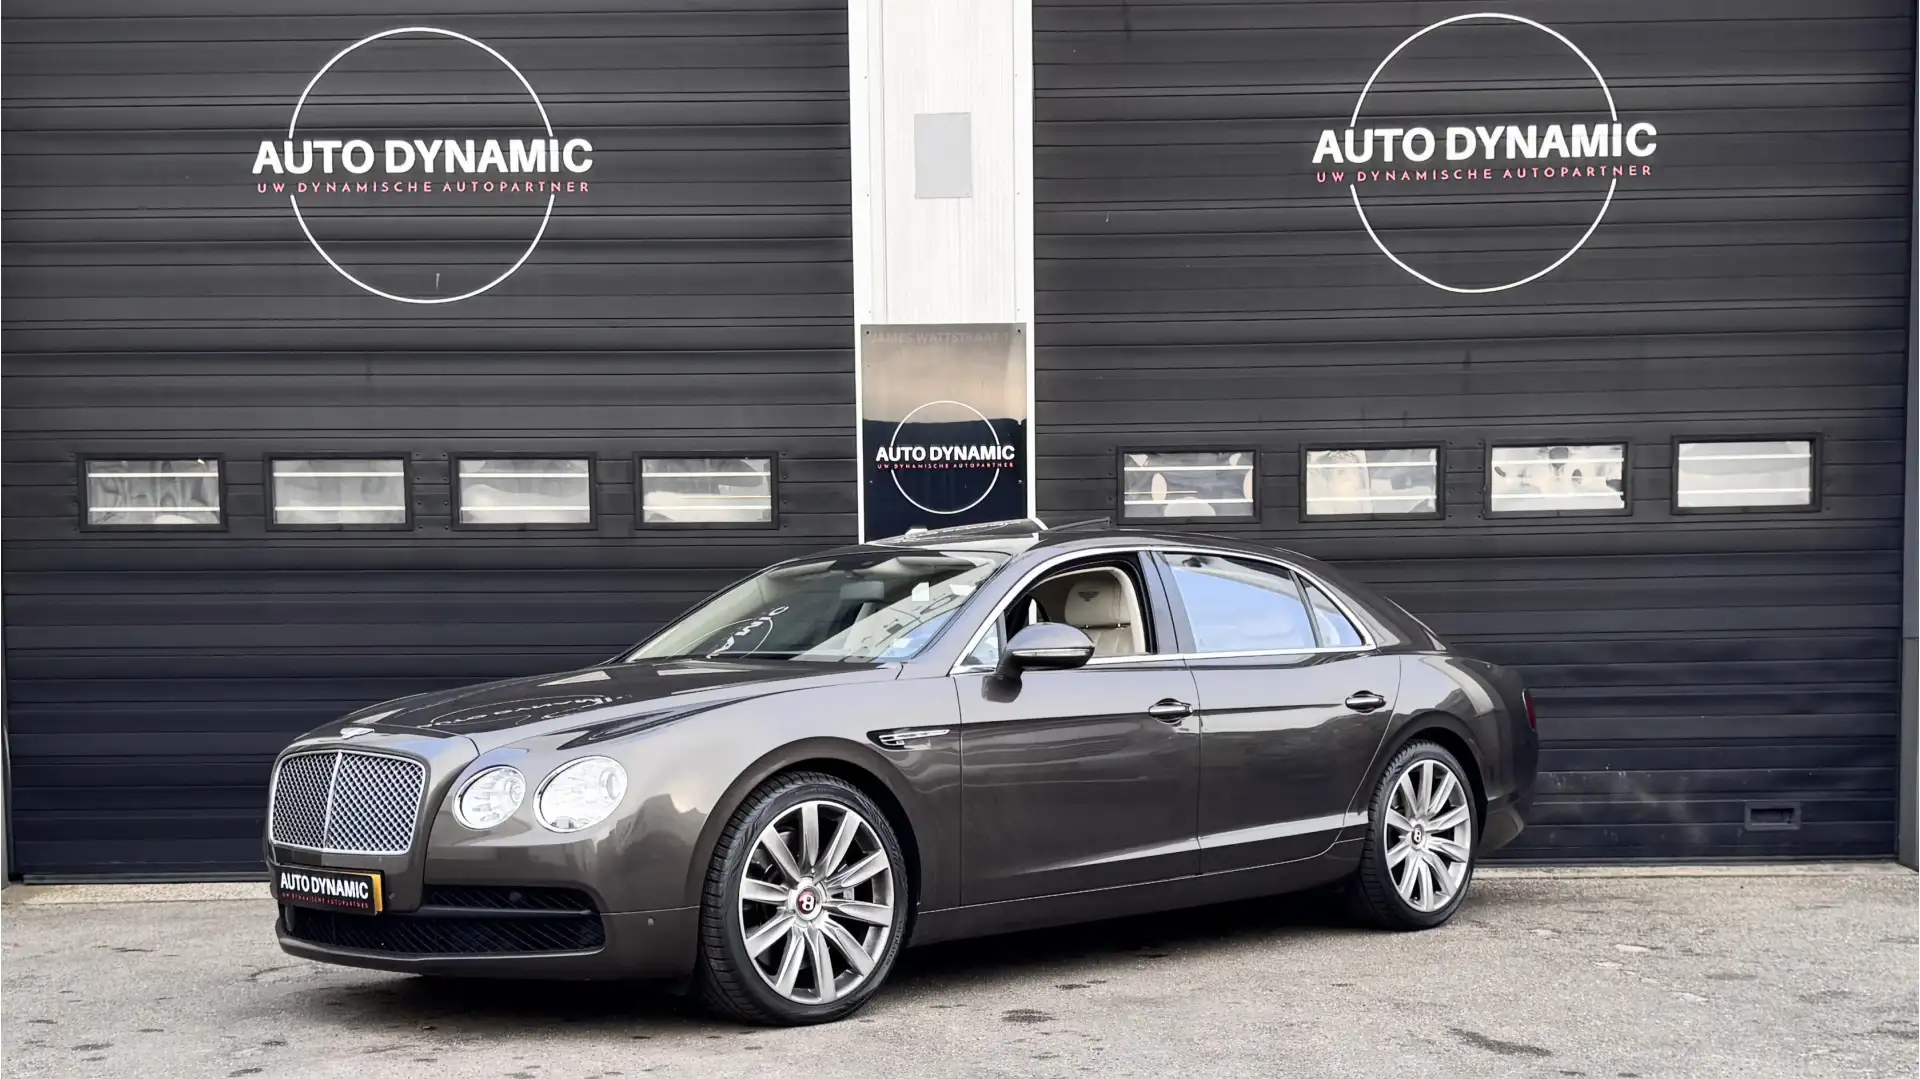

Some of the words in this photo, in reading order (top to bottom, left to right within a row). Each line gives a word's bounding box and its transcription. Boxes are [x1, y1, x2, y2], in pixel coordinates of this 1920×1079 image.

[1312, 127, 1435, 163] AUTO
[1446, 123, 1657, 160] DYNAMIC
[252, 140, 375, 175] AUTO
[385, 138, 593, 173] DYNAMIC
[1317, 172, 1345, 183] UW
[1357, 168, 1493, 182] DYNAMISCHE
[1503, 165, 1652, 179] AUTOPARTNER
[257, 182, 285, 193] UW
[298, 181, 433, 193] DYNAMISCHE
[443, 181, 590, 193] AUTOPARTNER
[875, 446, 927, 462] AUTO
[929, 445, 1015, 461] DYNAMIC
[280, 872, 310, 893] AUTO
[311, 876, 369, 900] DYNAMIC
